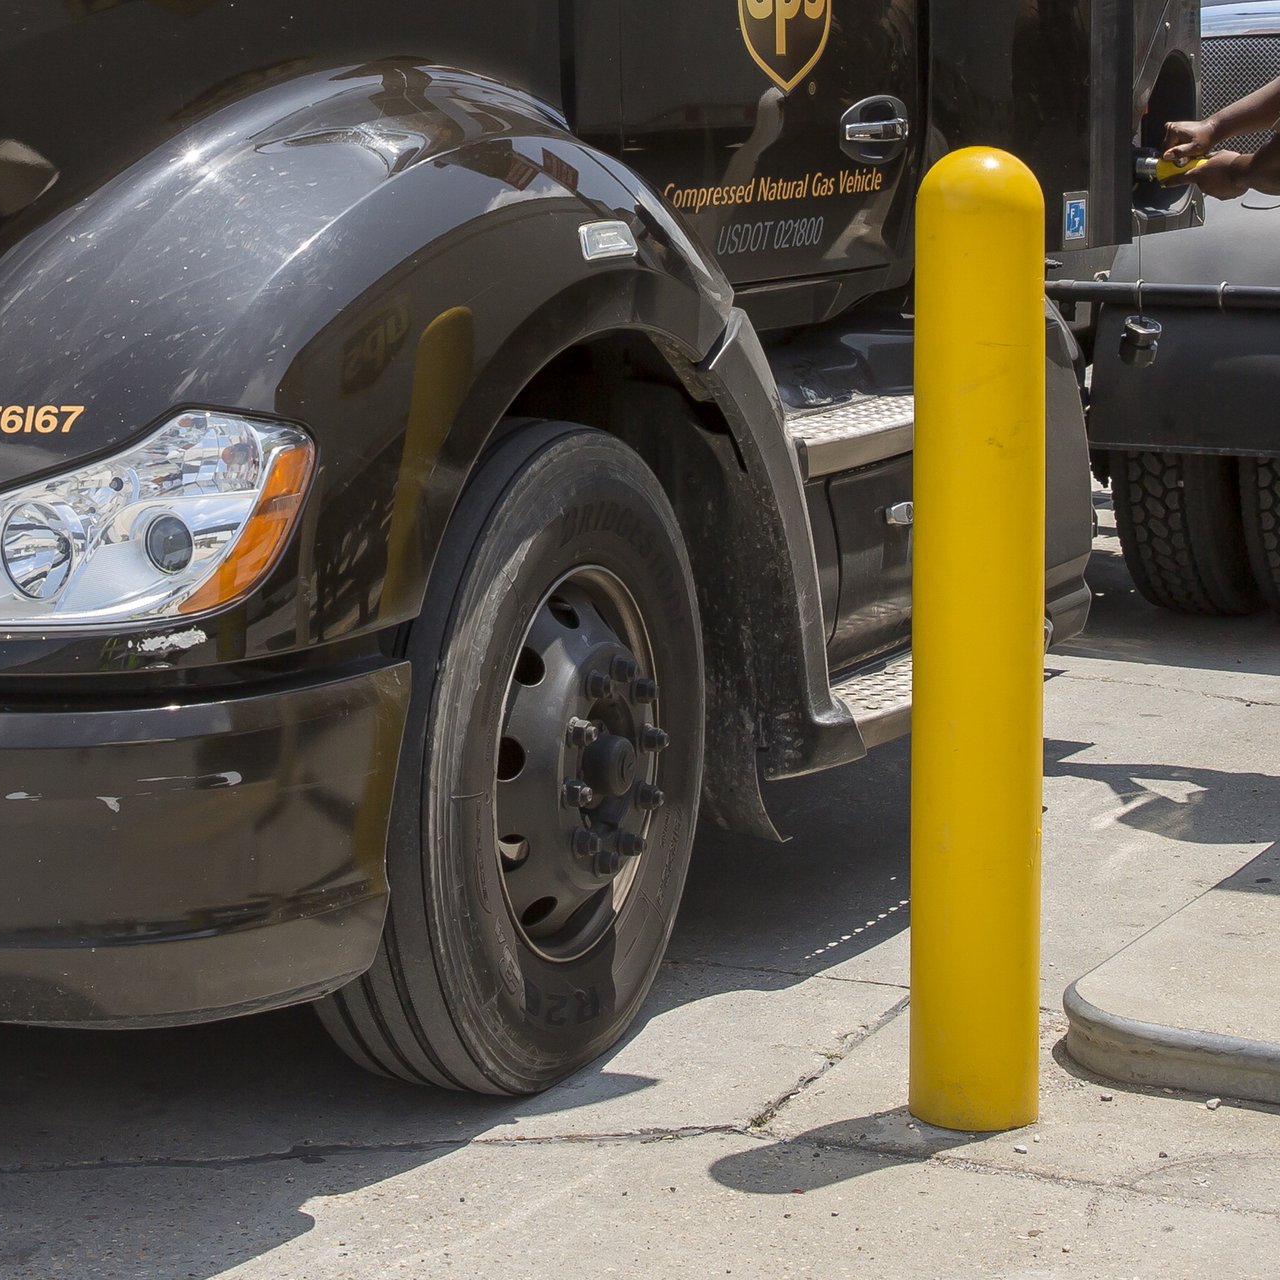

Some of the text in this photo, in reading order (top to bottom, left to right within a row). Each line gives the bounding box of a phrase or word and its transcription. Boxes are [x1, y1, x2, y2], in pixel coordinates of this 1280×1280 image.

[664, 167, 883, 214] Compressed Natural Gas Vehicle
[716, 216, 824, 256] USDOT 021800
